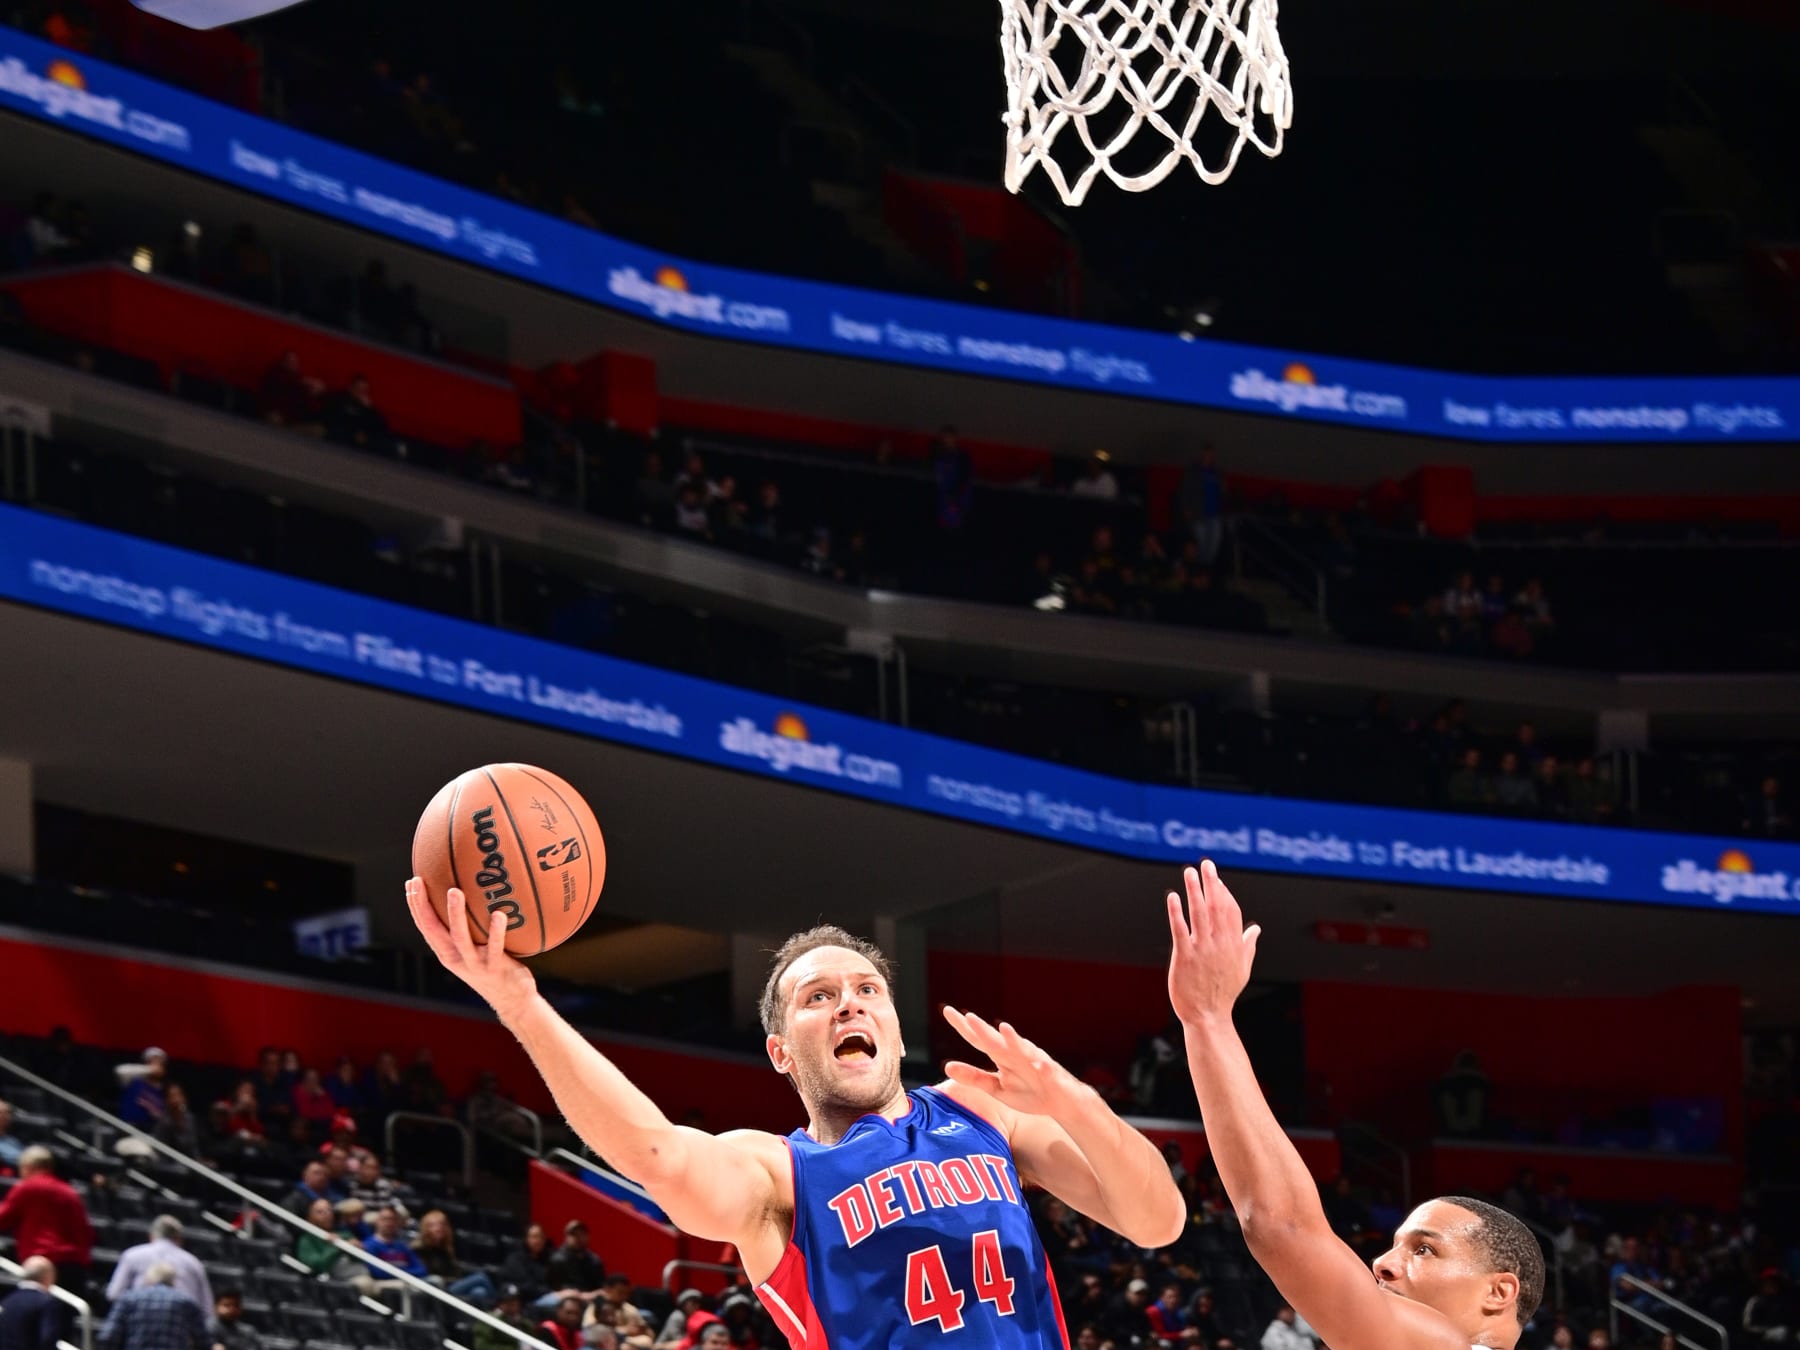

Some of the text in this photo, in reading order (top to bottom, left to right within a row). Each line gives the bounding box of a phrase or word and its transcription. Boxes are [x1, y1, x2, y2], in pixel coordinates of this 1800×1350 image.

[427, 655, 458, 685] to
[463, 659, 524, 701] Fort
[528, 677, 683, 737] Lauderdale
[720, 717, 902, 789] allegiant.com
[471, 804, 526, 932] Wilson
[1163, 820, 1251, 854] Grand
[1256, 829, 1352, 864] Rapids
[1358, 842, 1387, 865] to
[1392, 841, 1451, 871] Fort
[1455, 847, 1610, 885] Lauderdale
[827, 1153, 1018, 1248] DETROIT
[905, 1229, 1016, 1334] 44
